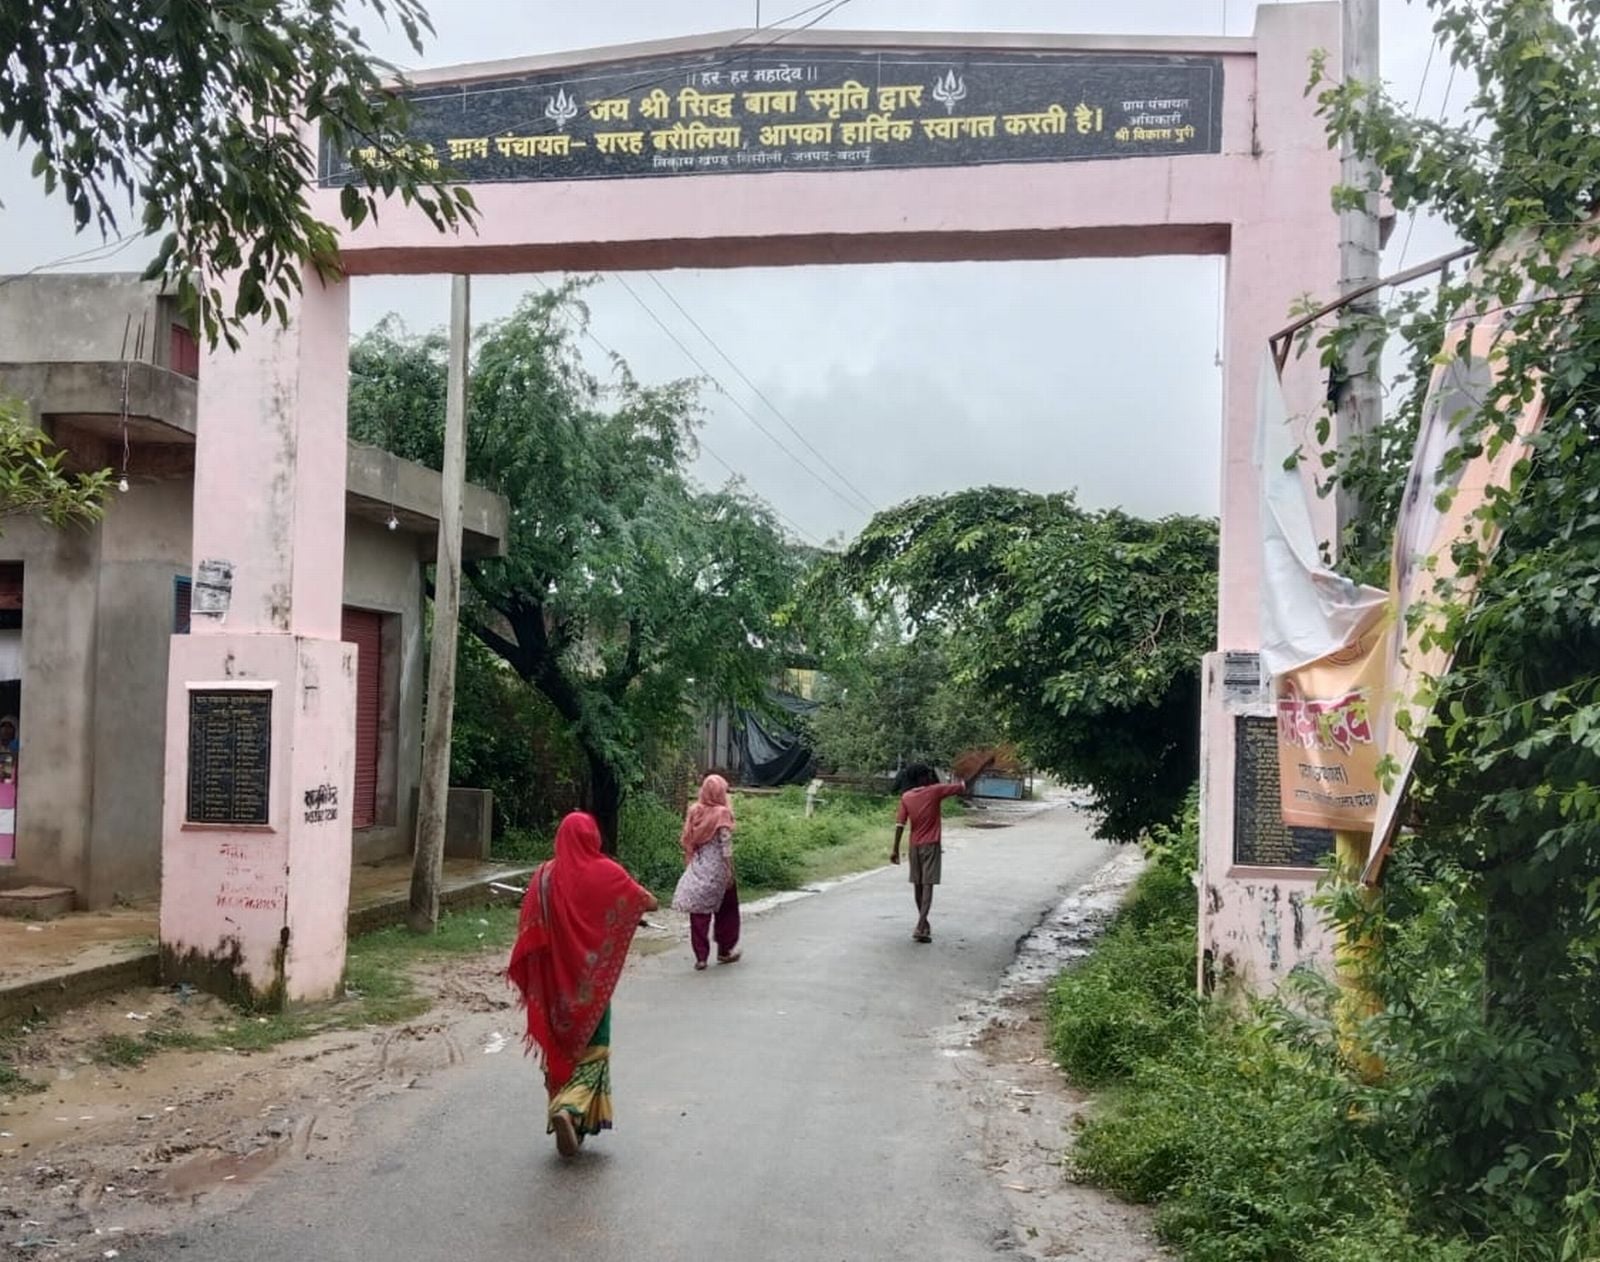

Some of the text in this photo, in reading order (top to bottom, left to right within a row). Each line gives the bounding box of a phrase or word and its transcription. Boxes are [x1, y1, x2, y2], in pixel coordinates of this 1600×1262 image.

[753, 63, 802, 83] महादेव
[588, 80, 925, 121] जय श्री सिद्ध बाबा स्मृति द्वार
[447, 138, 488, 161] ग्राम
[758, 122, 833, 146] आपका
[840, 112, 914, 145] हार्दिक
[920, 116, 997, 141] स्वागत
[1003, 104, 1067, 135] करती
[1114, 126, 1129, 142] श्री
[1133, 127, 1172, 141] विकास
